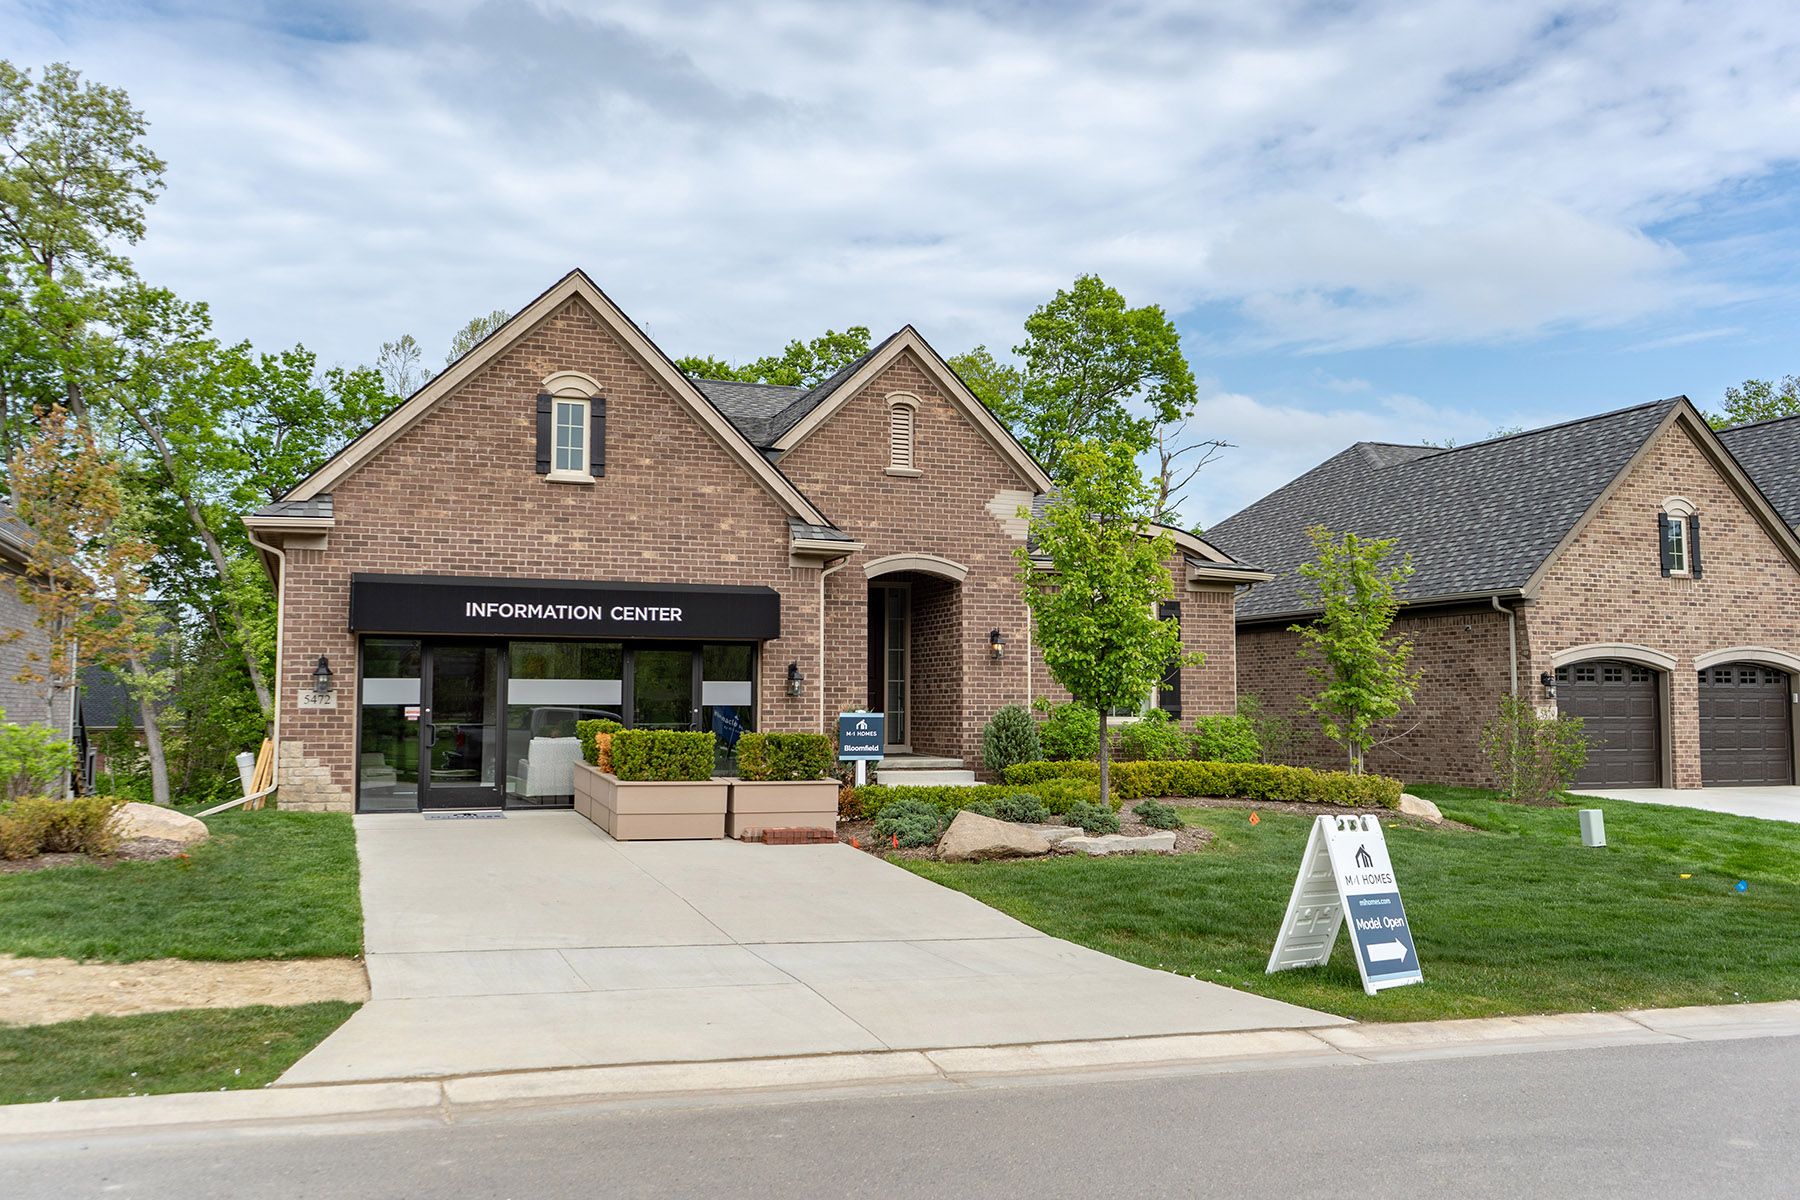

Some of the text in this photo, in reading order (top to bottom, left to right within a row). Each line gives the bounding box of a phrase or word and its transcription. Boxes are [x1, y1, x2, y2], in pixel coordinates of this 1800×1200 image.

[465, 602, 683, 622] INFORMATION CENTER
[303, 694, 331, 705] 5472
[1362, 873, 1392, 884] HOMES
[1356, 916, 1405, 930] Model Open
